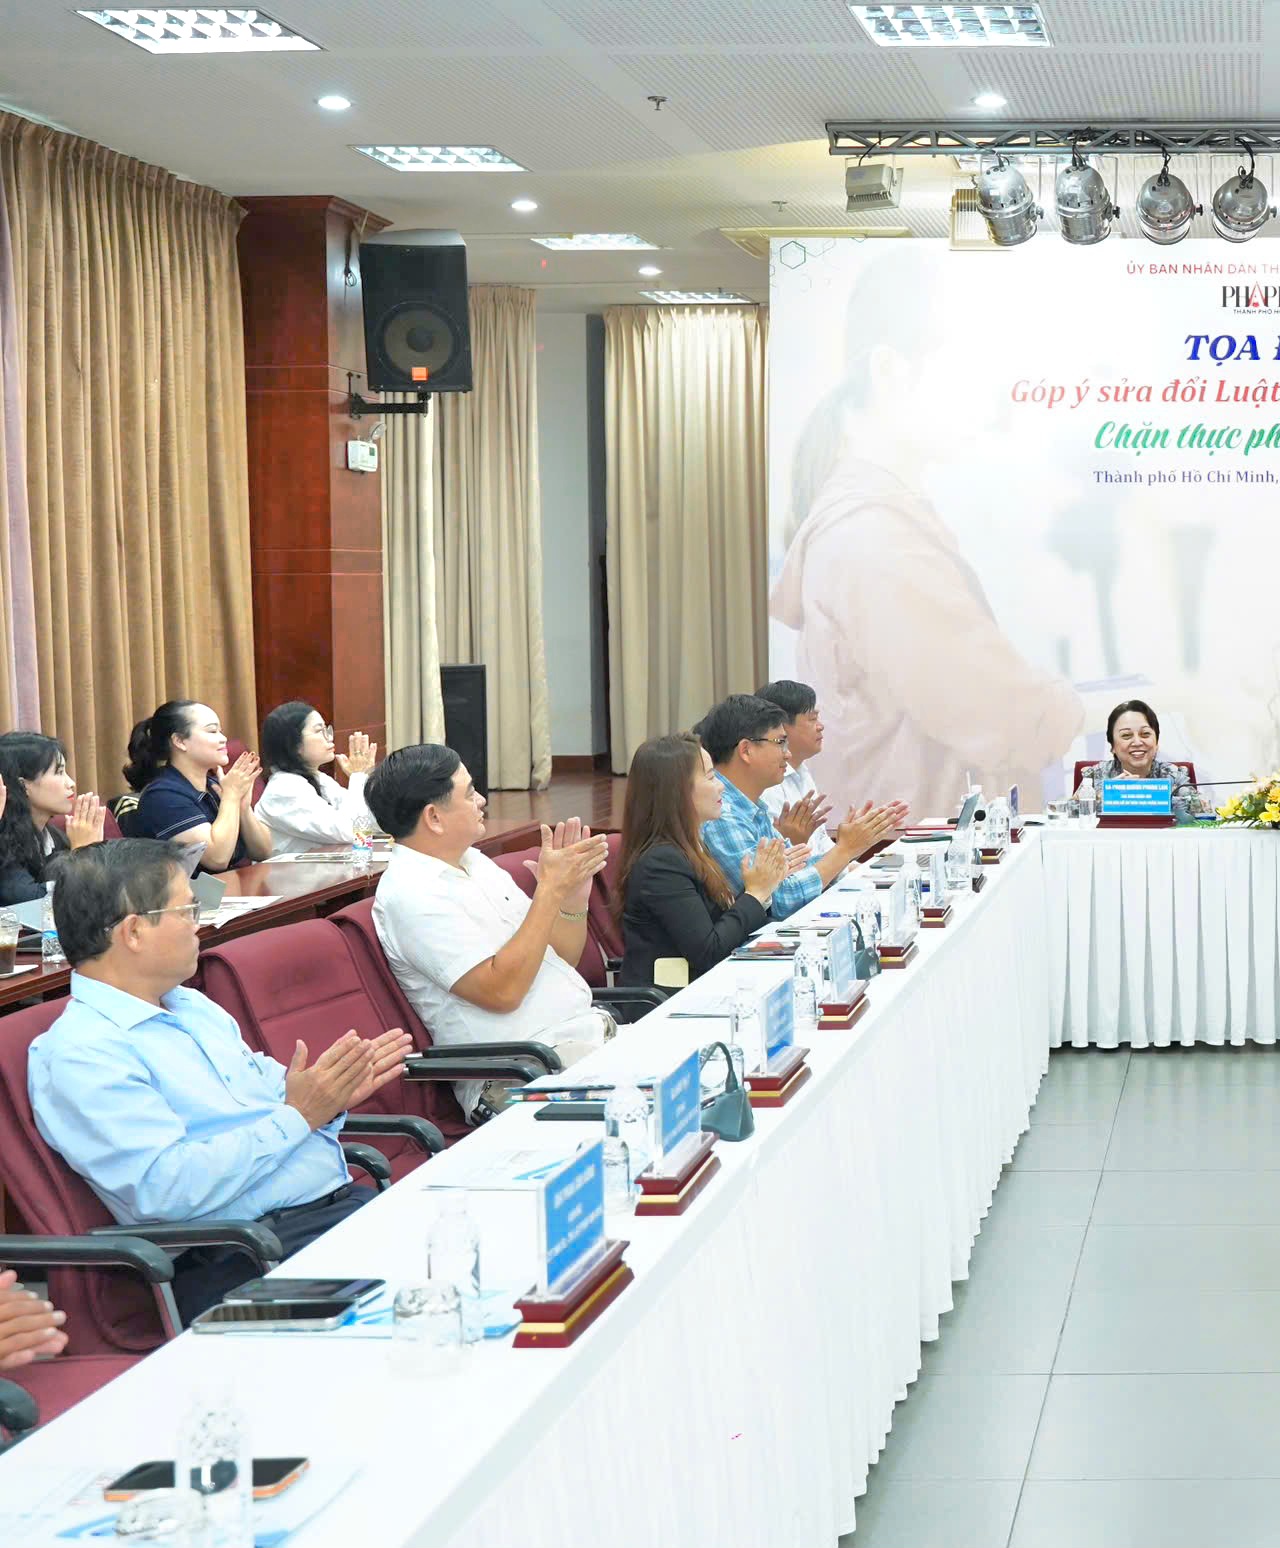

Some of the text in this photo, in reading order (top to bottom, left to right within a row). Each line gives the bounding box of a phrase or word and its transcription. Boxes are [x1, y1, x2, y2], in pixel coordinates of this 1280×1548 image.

[1149, 264, 1178, 274] BAN
[1182, 261, 1223, 274] NHÂN
[1184, 334, 1261, 366] TỌA
[1011, 378, 1065, 409] Góp
[1071, 378, 1090, 409] ý
[1097, 376, 1153, 403] sửa
[1162, 375, 1208, 403] đổi
[1094, 420, 1171, 457] Chặn
[1177, 422, 1242, 457] thực
[1093, 470, 1143, 483] Thành
[1148, 469, 1176, 487] phố
[1182, 469, 1202, 483] Hồ
[1207, 469, 1231, 483] Chí
[1236, 470, 1279, 485] Minh,
